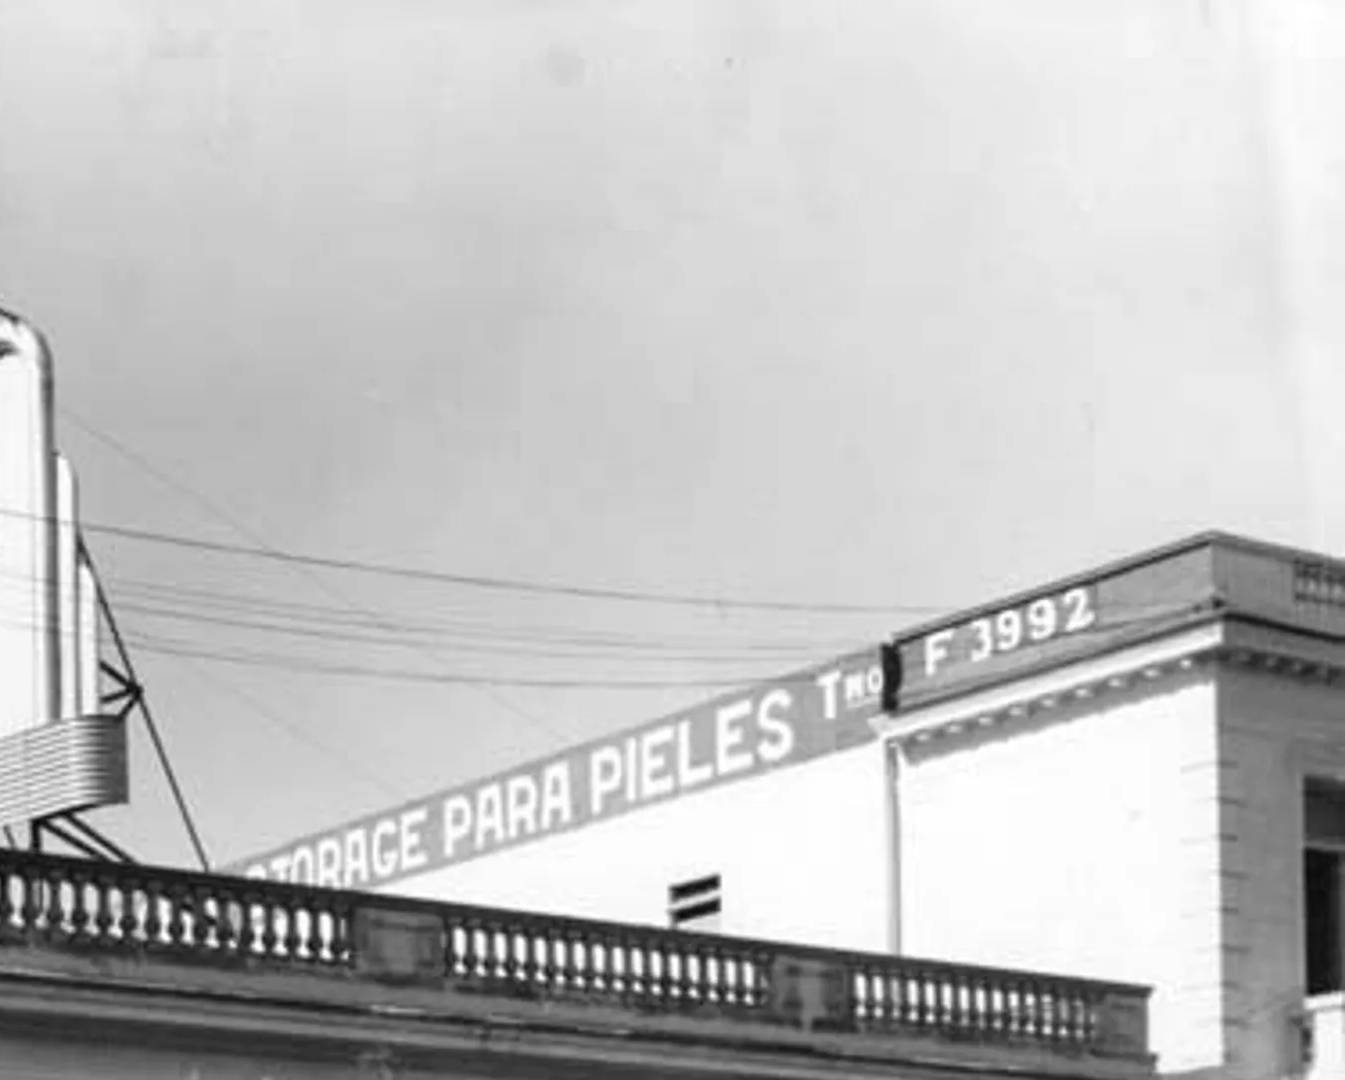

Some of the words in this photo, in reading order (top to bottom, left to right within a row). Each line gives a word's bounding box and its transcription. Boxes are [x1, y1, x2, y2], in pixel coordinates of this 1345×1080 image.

[443, 762, 571, 857] PARA
[591, 689, 793, 813] PIELES
[924, 631, 953, 677] F
[971, 588, 1095, 662] 3992
